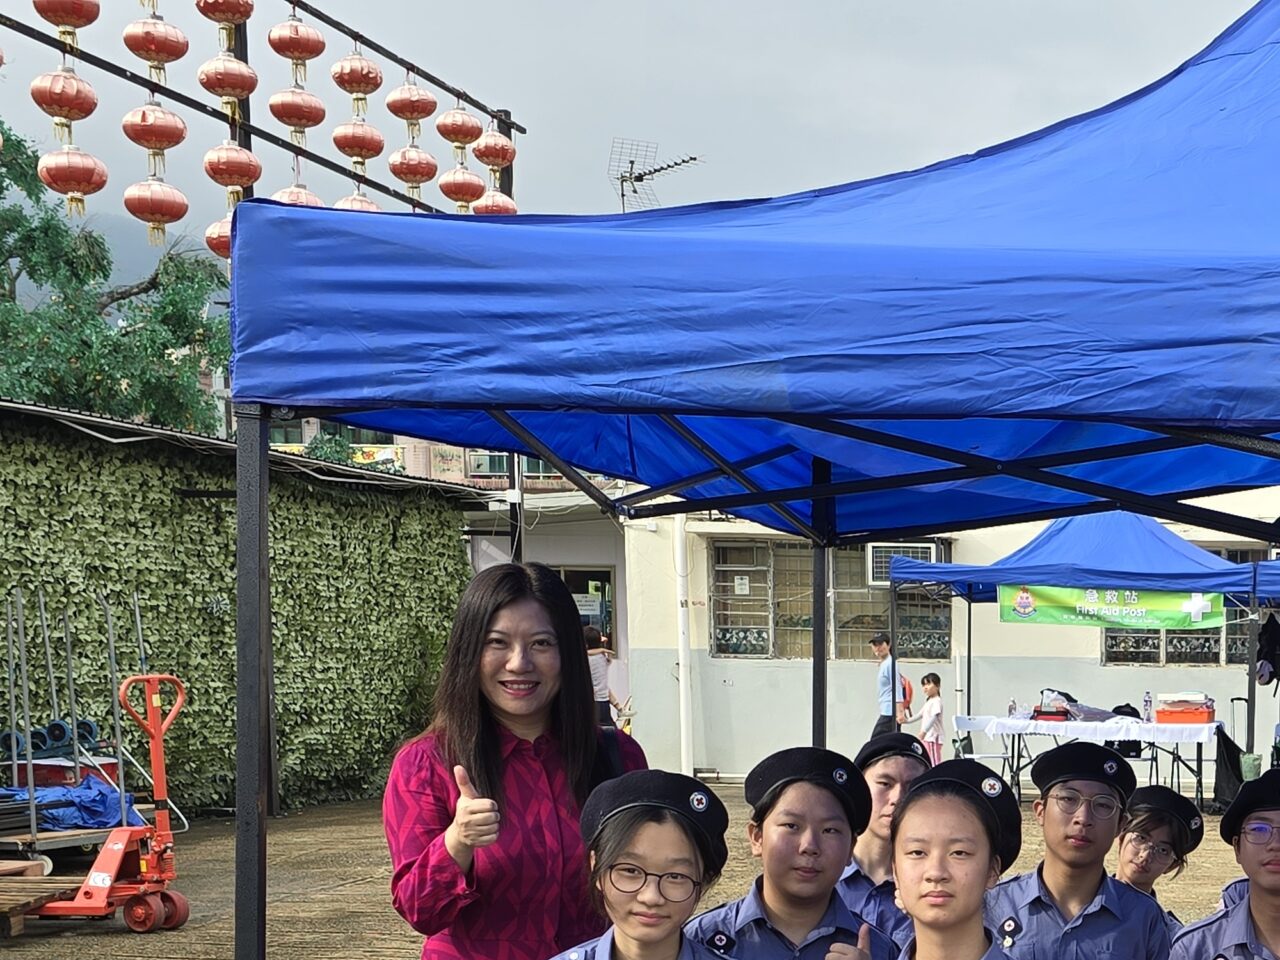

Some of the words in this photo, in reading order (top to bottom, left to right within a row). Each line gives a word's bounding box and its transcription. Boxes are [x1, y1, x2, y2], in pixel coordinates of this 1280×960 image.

[1085, 588, 1138, 604] 急救站
[1076, 605, 1099, 615] First
[1101, 606, 1120, 616] Aid
[1122, 607, 1147, 617] Post
